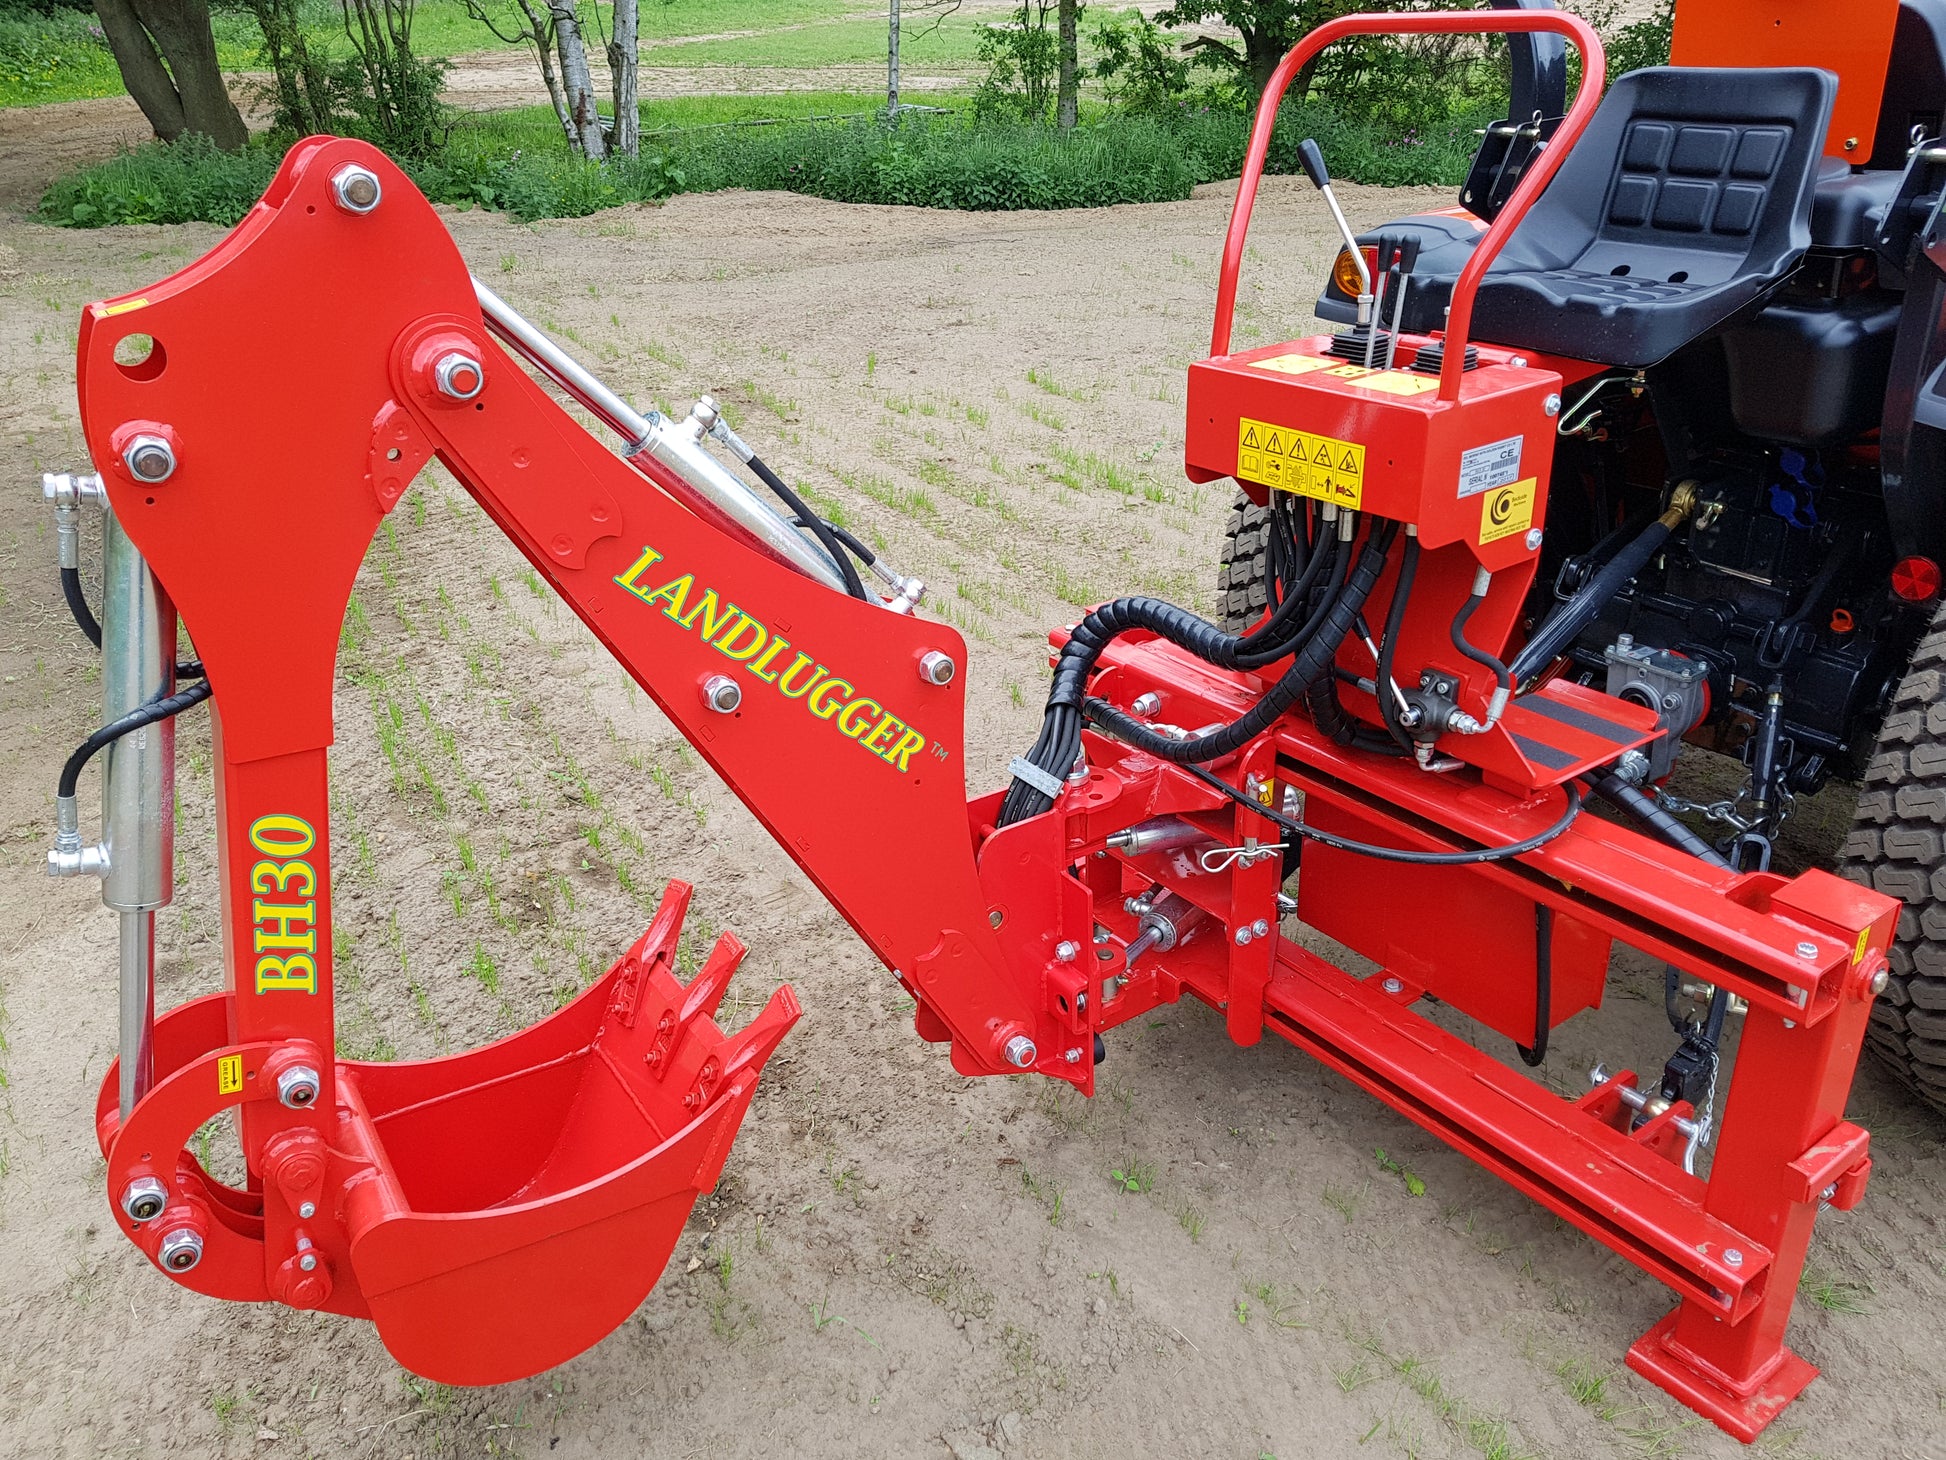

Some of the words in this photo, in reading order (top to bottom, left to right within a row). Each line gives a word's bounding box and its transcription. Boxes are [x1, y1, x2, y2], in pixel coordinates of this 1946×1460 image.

[1500, 448, 1515, 459] CE
[612, 545, 927, 774] LANDLUGGER
[248, 813, 318, 996] BH30
